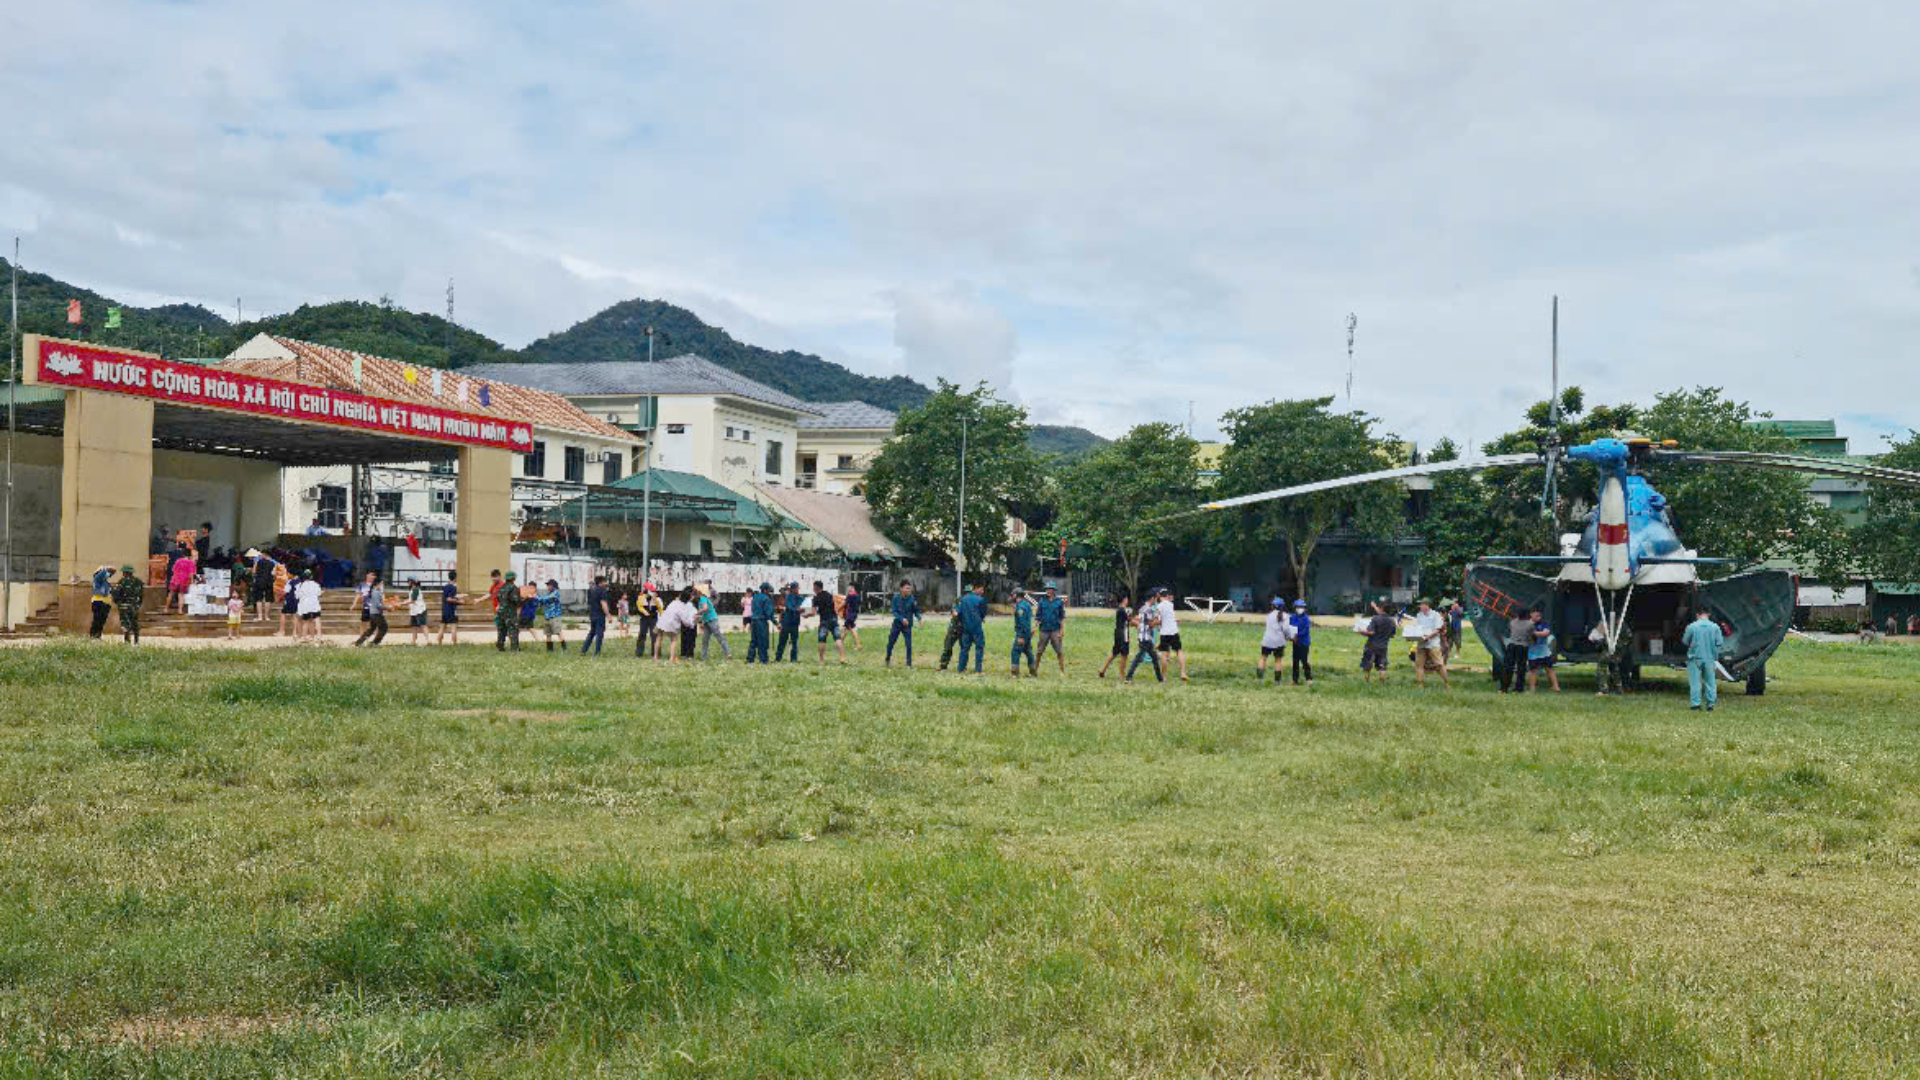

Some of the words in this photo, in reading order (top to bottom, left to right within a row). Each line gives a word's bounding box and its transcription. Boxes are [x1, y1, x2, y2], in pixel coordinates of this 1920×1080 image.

[152, 368, 201, 395] CỘNG
[204, 376, 239, 402] HÒA
[411, 411, 442, 433] NAM
